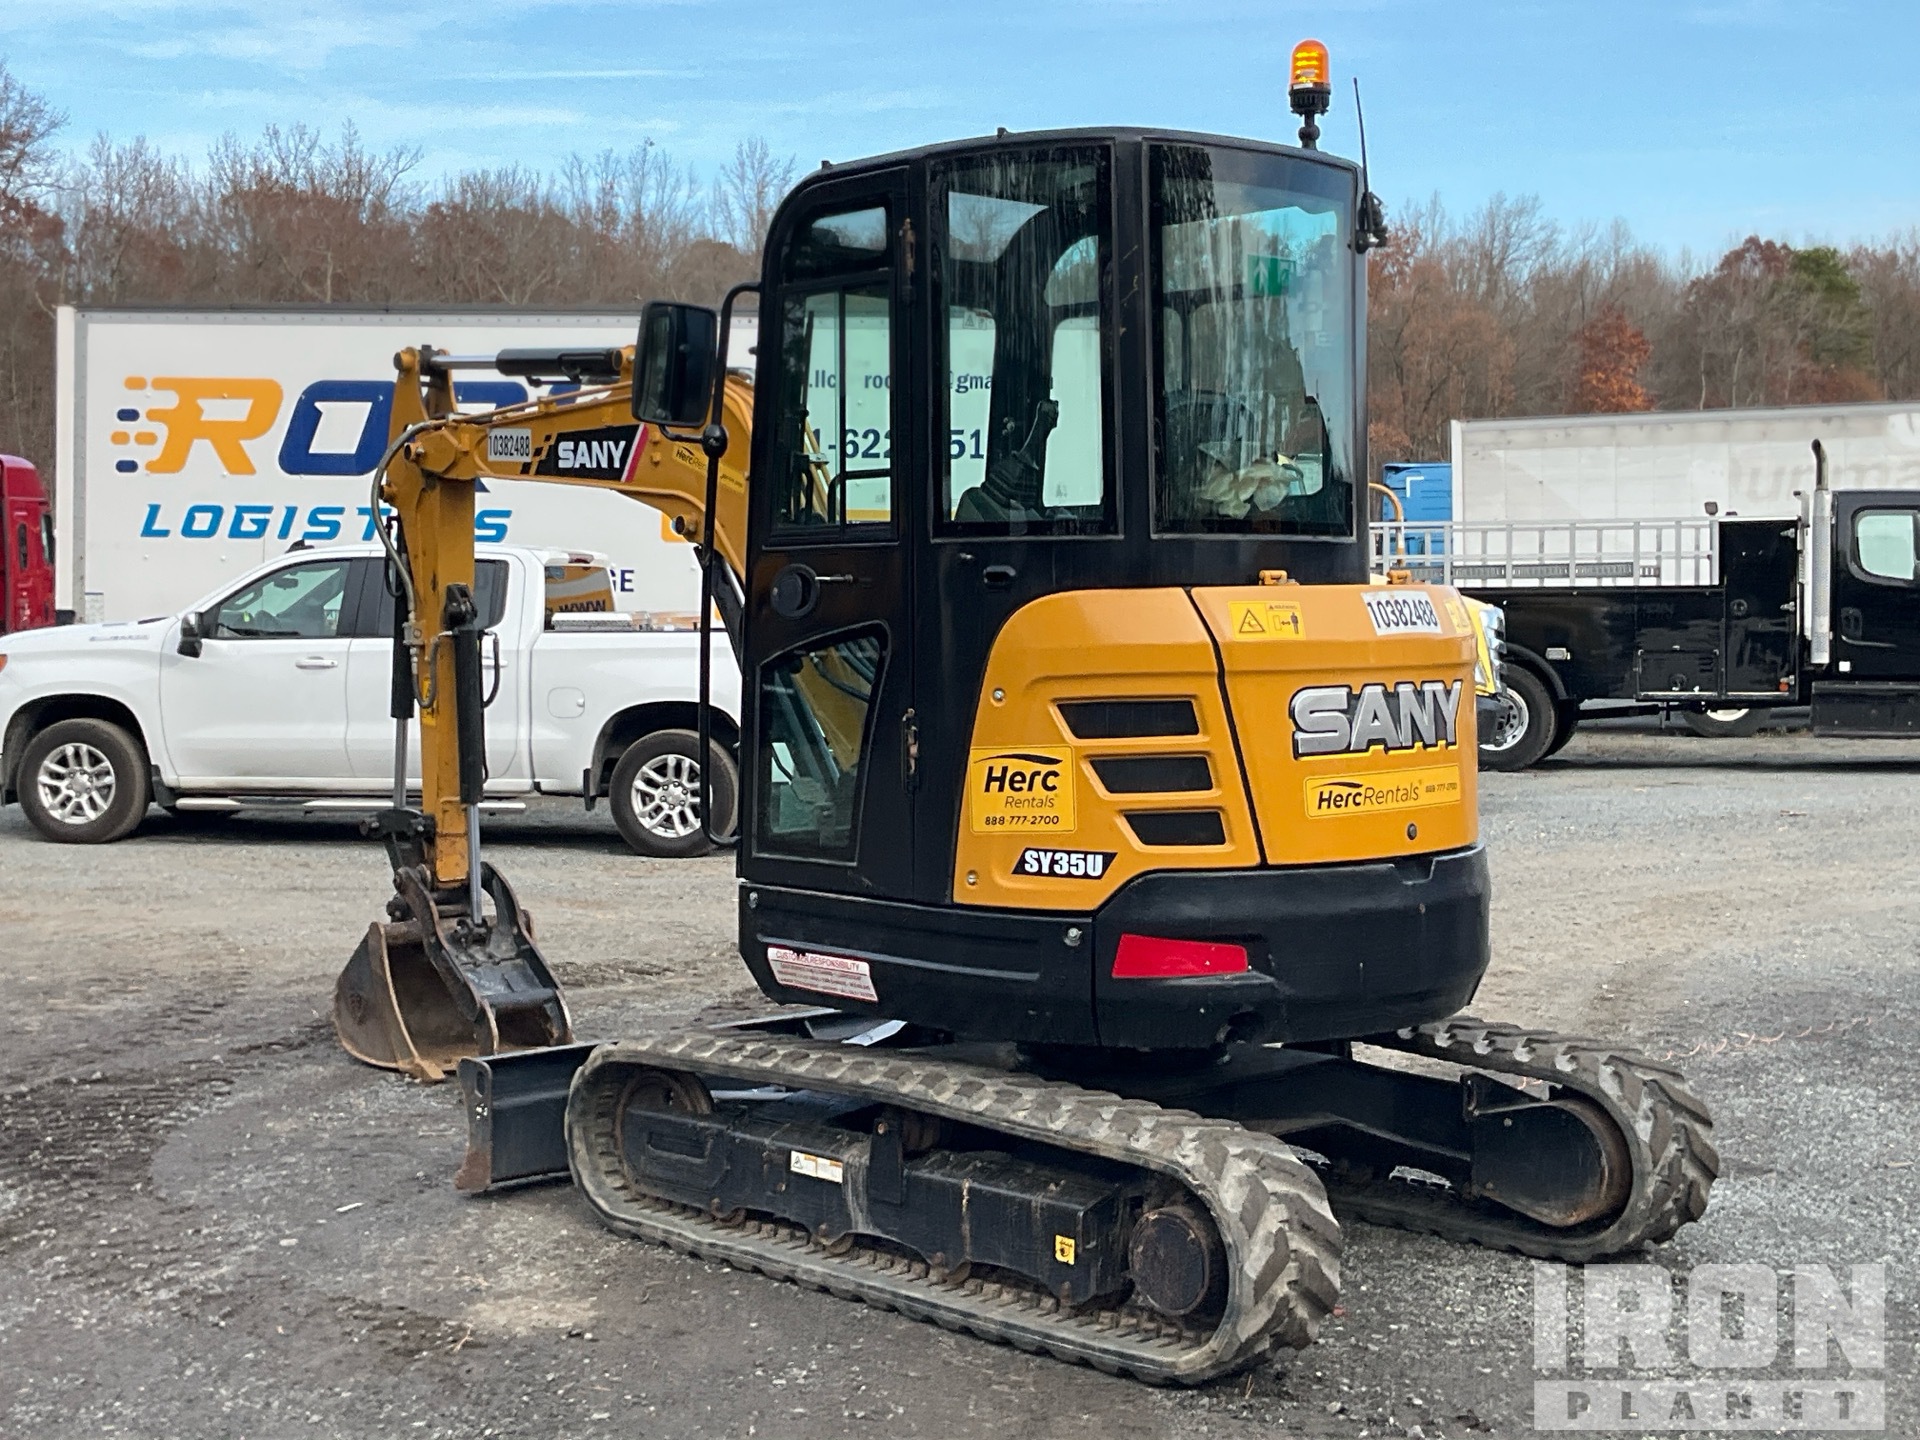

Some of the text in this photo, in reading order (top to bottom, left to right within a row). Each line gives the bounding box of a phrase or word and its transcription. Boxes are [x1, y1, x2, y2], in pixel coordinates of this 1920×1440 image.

[489, 434, 530, 457] 10382488
[558, 440, 626, 469] SANY
[140, 503, 513, 542] LOGISTS
[1367, 600, 1437, 629] 10382488
[1290, 679, 1463, 760] SANY
[984, 766, 1060, 793] Herc
[1004, 795, 1055, 809] Rentals
[1024, 850, 1104, 877] SY35U
